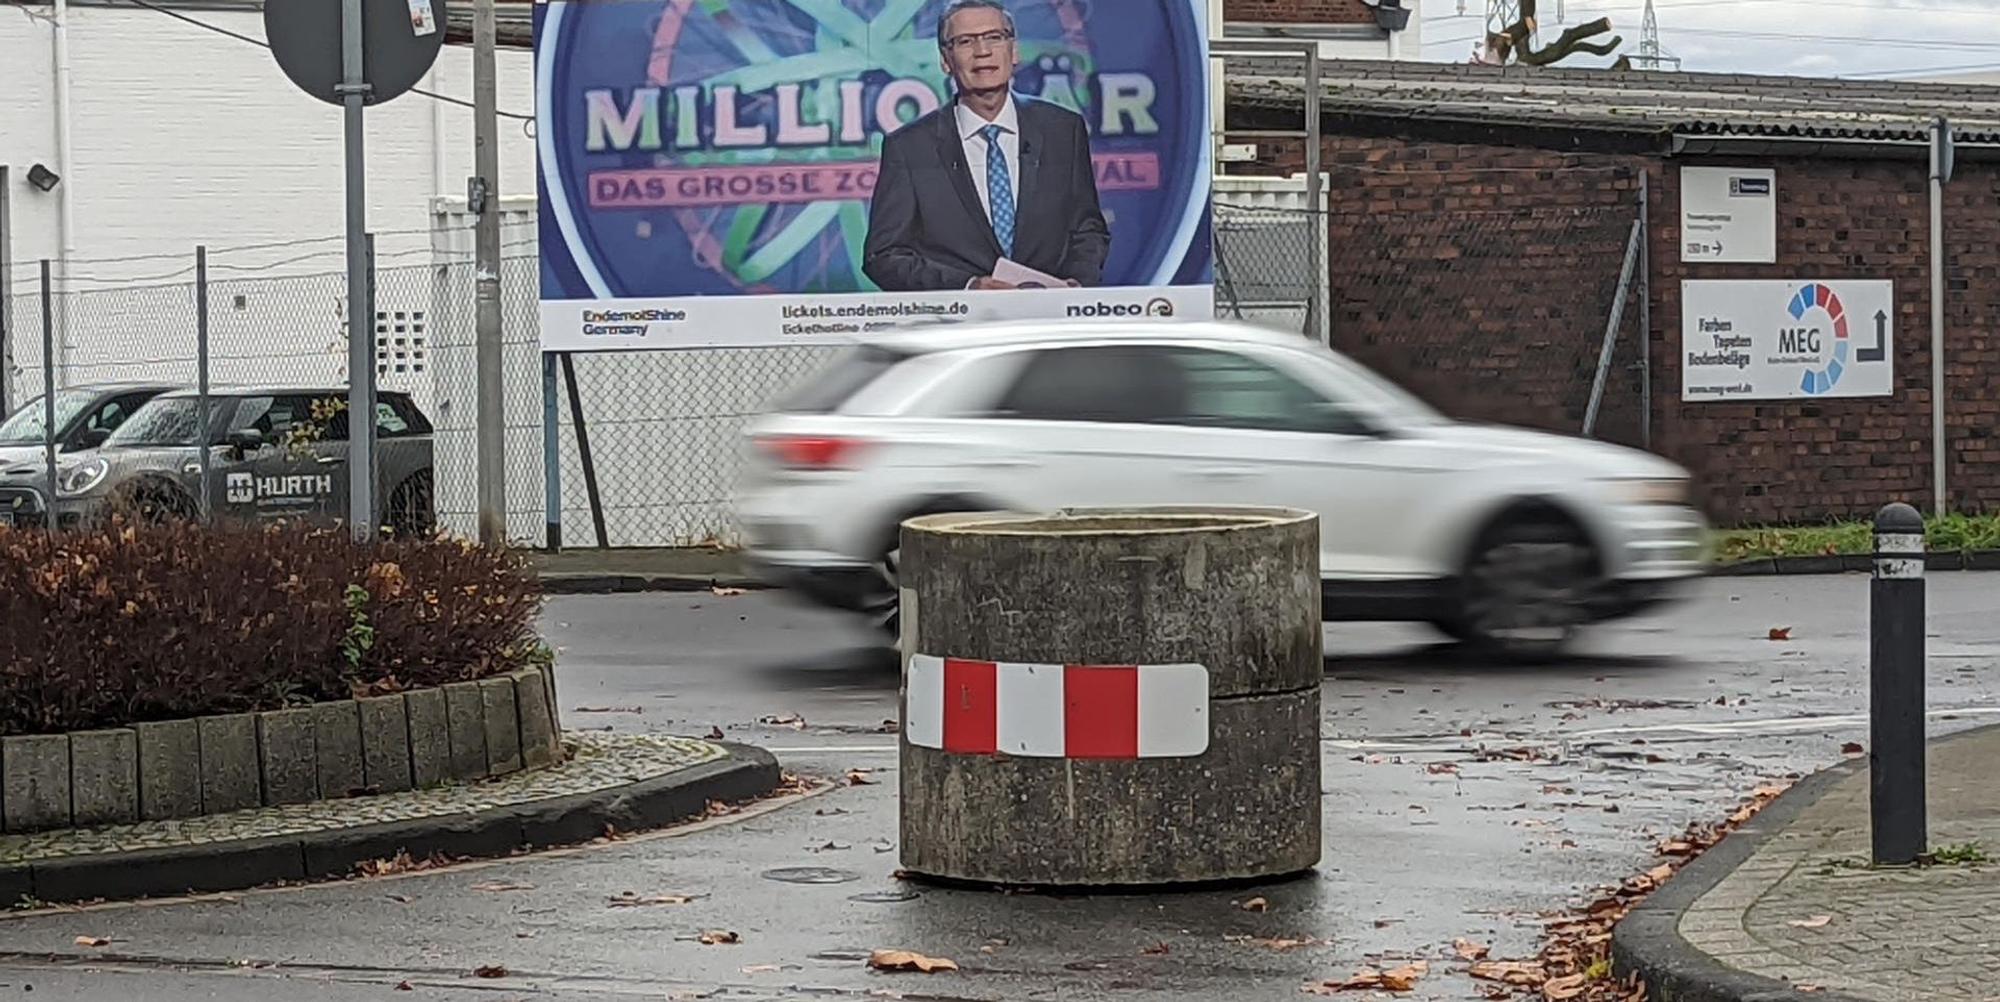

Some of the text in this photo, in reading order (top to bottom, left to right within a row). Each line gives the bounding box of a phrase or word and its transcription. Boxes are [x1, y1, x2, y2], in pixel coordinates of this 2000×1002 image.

[585, 57, 1159, 149] MILLIOÄR
[596, 177, 666, 201] DAS
[677, 172, 820, 198] GROSSE
[583, 309, 686, 322] EndemolShine
[782, 301, 969, 318] tickets.endemolshine.de
[1066, 302, 1142, 316] nobeo
[583, 323, 648, 336] Germany
[1699, 317, 1732, 332] Farben
[1713, 334, 1752, 351] Tapeten
[1779, 328, 1820, 353] MEG
[1688, 351, 1750, 369] Bodenbeläge
